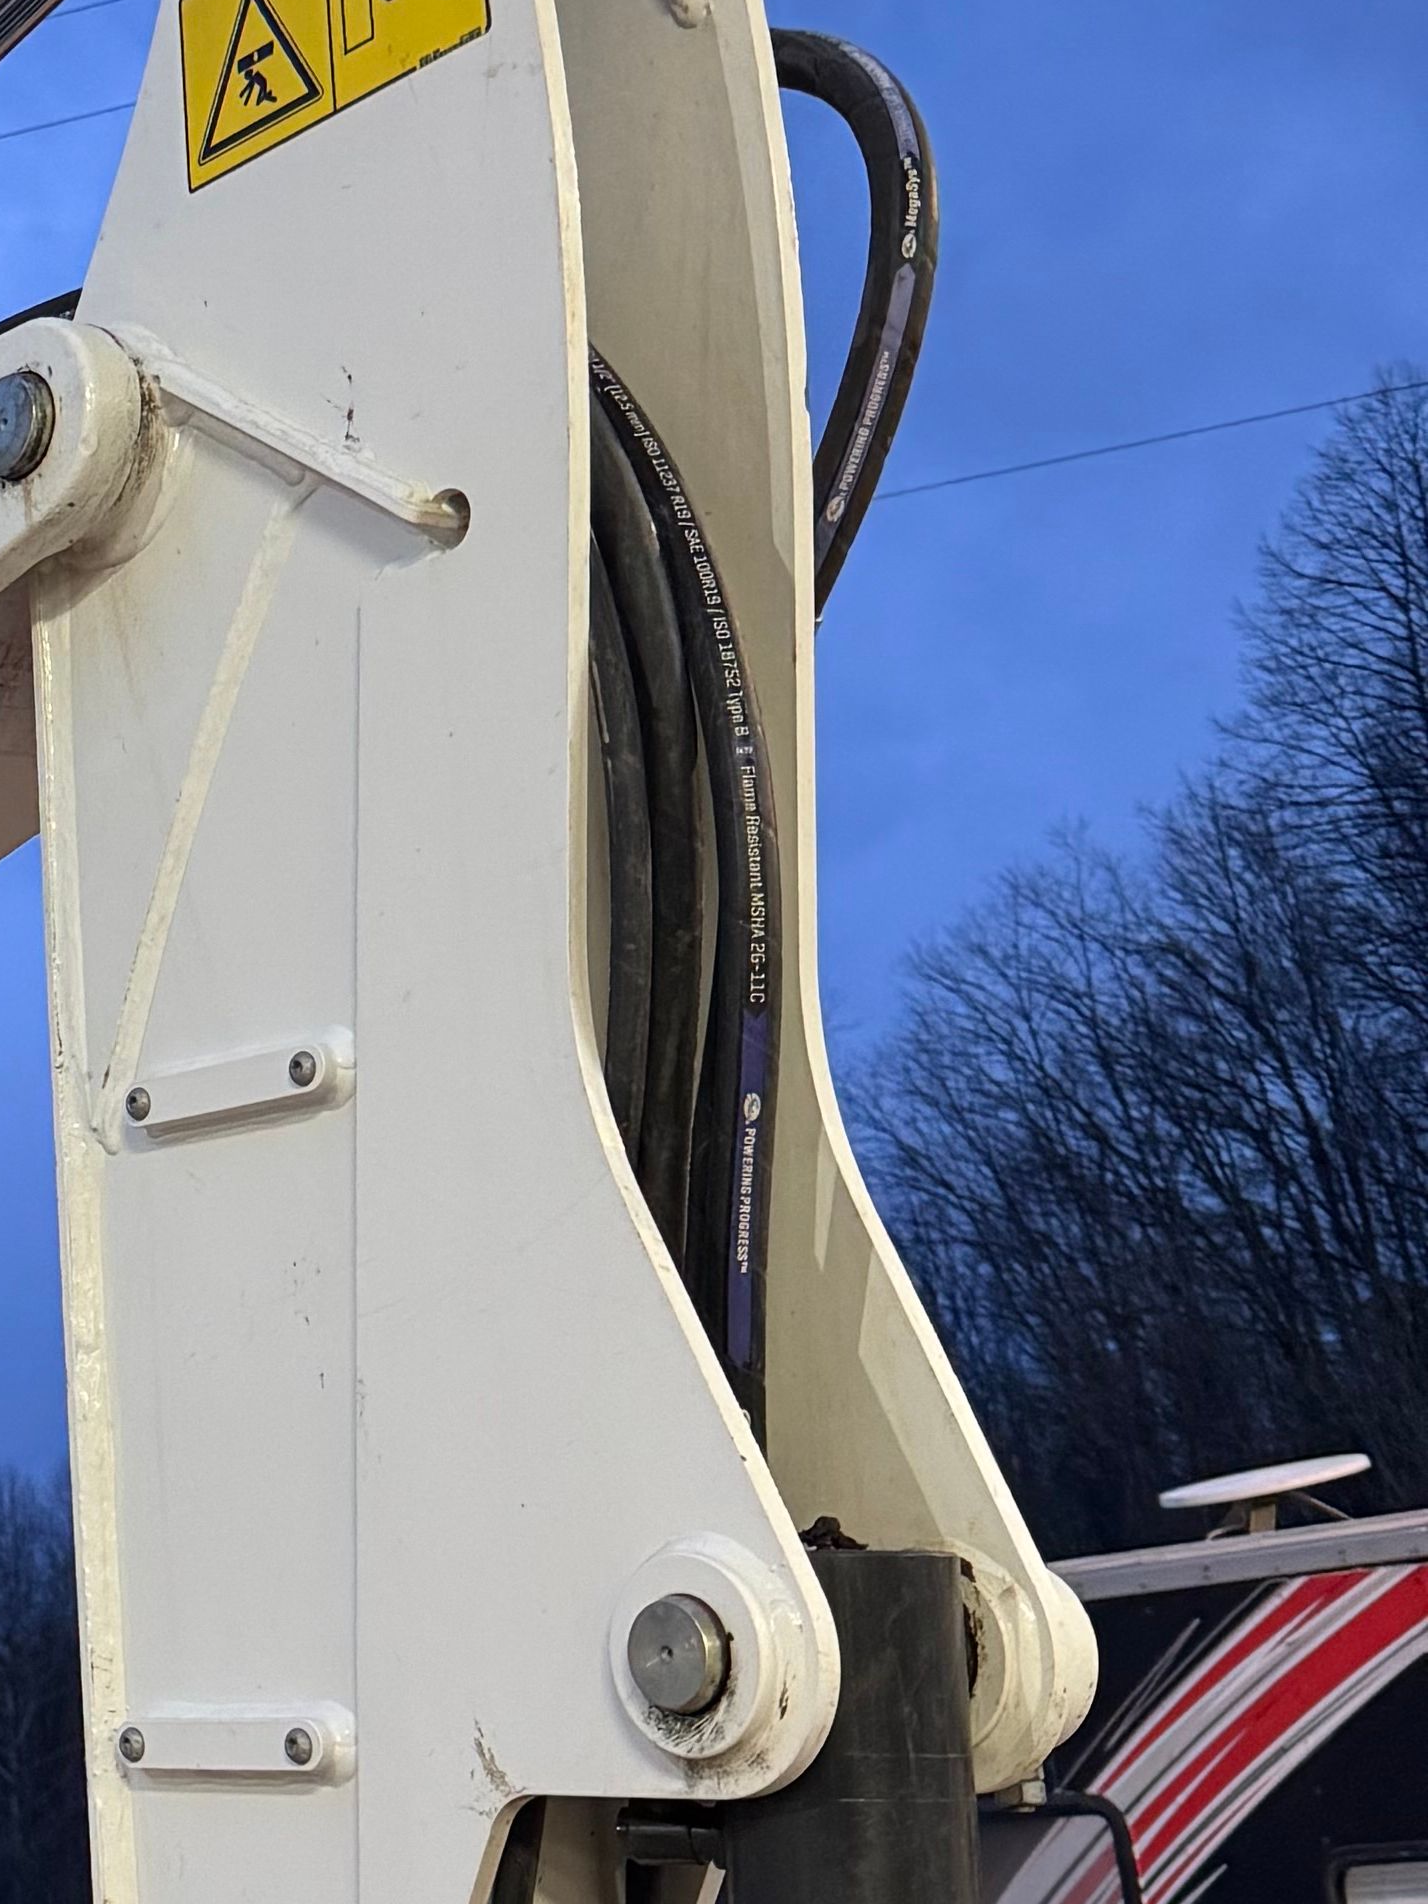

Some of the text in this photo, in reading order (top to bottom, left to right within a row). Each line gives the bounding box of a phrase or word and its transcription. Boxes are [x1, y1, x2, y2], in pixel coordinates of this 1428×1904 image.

[642, 437, 662, 457] ISO
[685, 529, 705, 554] SAE
[693, 556, 722, 605] 100R19
[712, 616, 731, 639] ISO
[718, 643, 741, 688] 18752
[740, 765, 757, 812] Flame
[745, 815, 763, 891] Resistant
[750, 893, 766, 939] MSHA
[741, 1127, 757, 1195] POWERING
